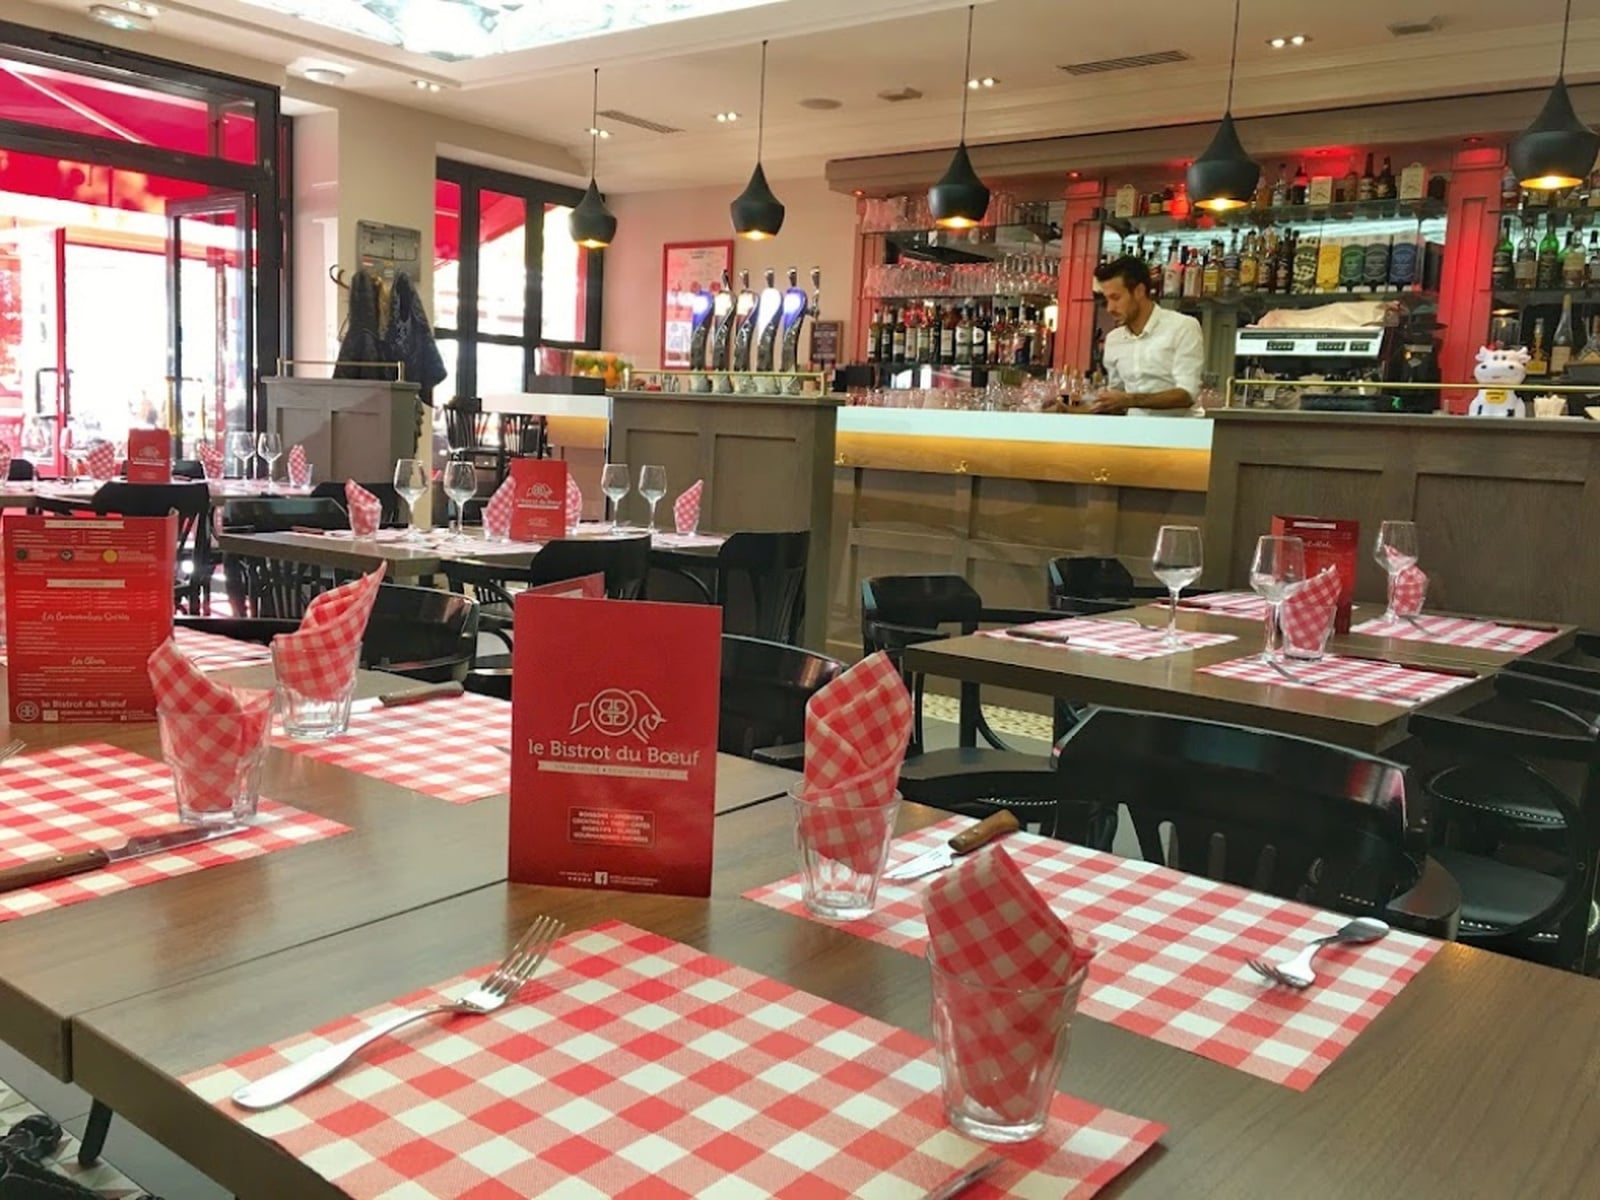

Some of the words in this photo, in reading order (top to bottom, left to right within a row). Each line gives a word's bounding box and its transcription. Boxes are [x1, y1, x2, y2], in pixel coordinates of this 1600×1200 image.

[528, 739, 544, 755] le
[549, 741, 610, 760] Bistrot
[616, 745, 641, 762] du
[647, 748, 701, 766] Bœuf
